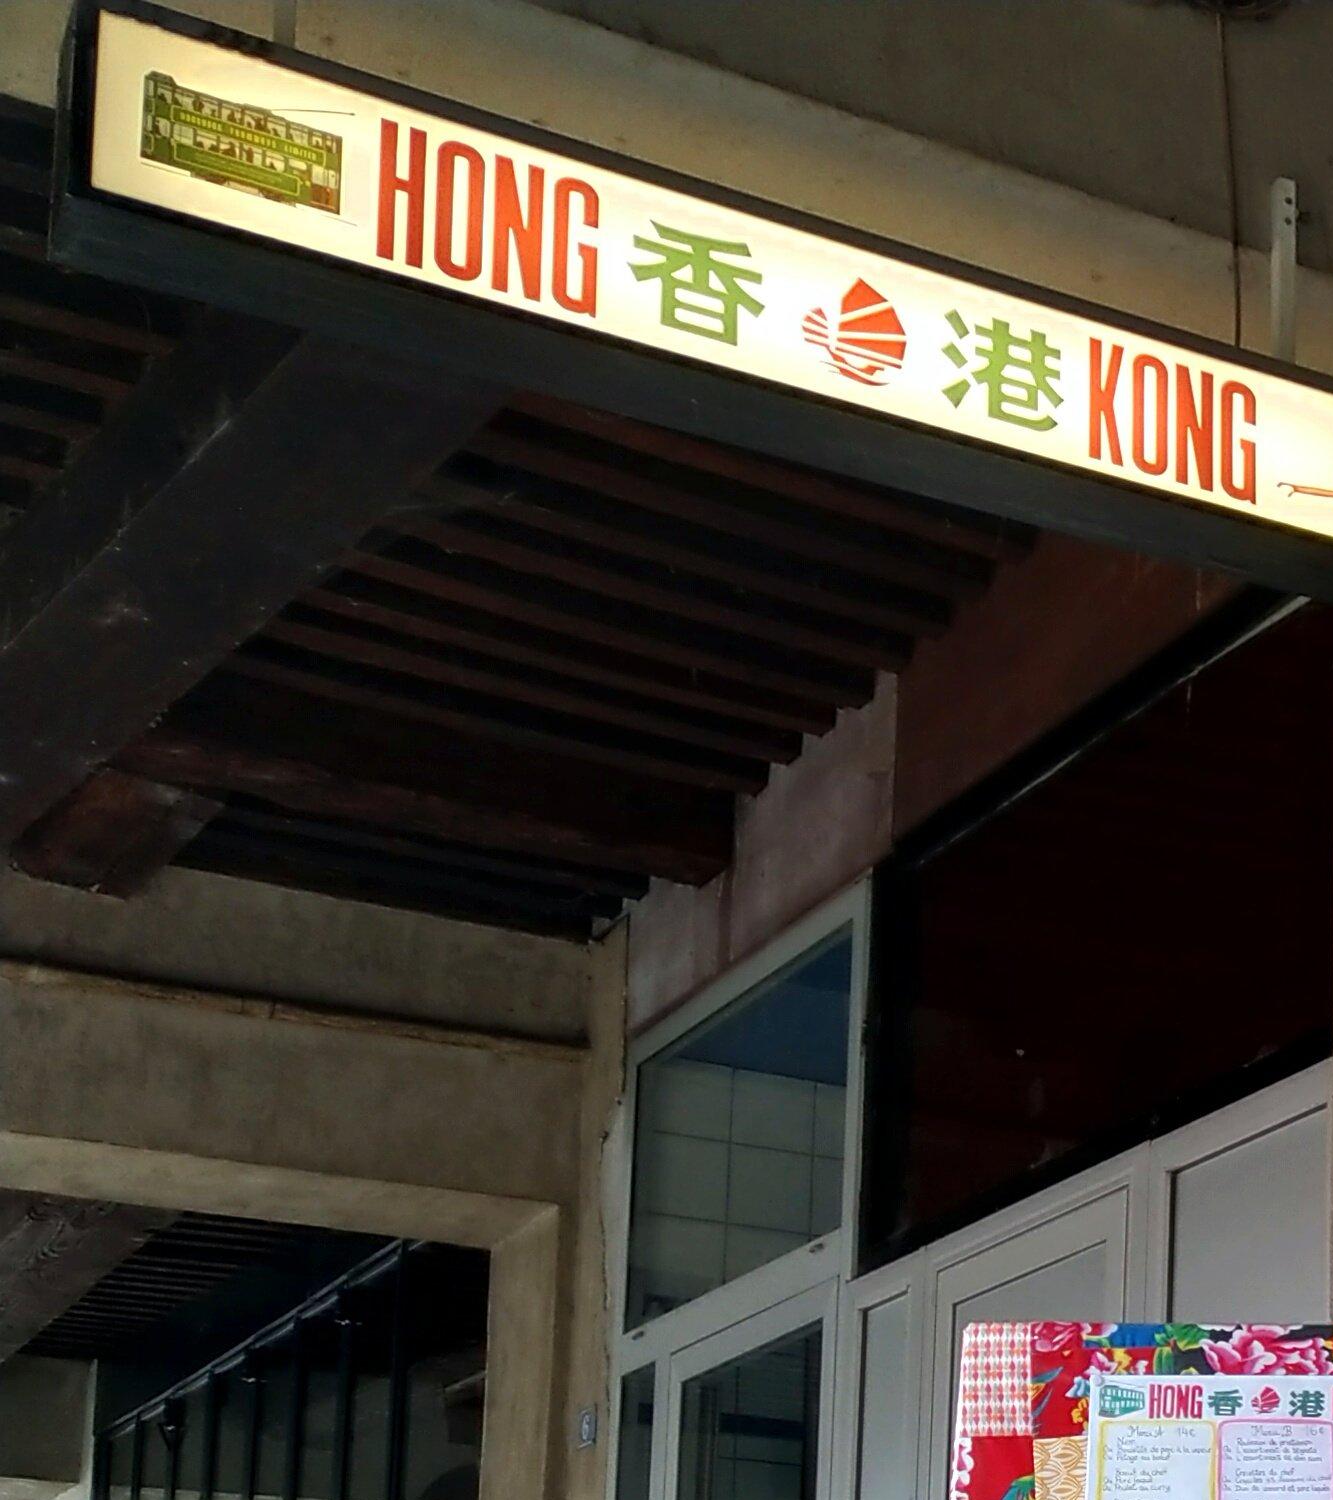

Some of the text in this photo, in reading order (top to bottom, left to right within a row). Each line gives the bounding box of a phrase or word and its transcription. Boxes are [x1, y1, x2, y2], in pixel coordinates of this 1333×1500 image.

[376, 117, 1257, 505] HONG 香 港 KONG
[1149, 1383, 1203, 1420] HONG
[1207, 1388, 1243, 1416] 香
[1288, 1390, 1326, 1418] 港
